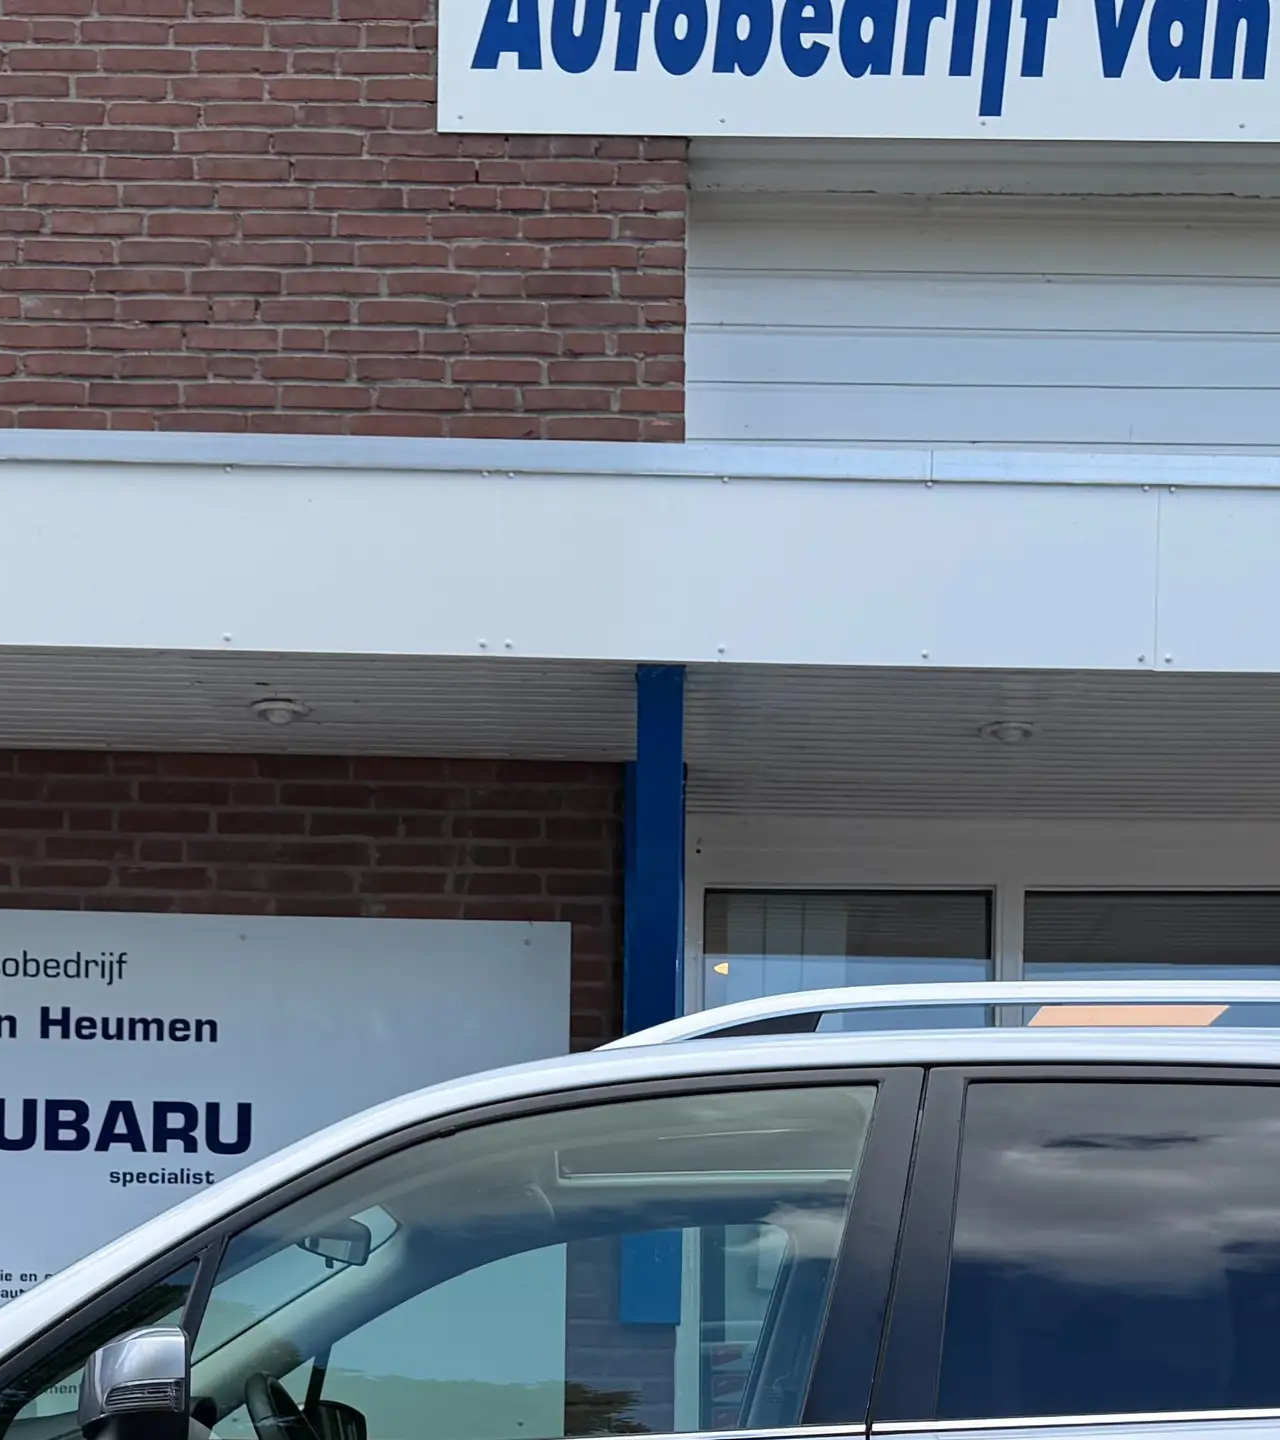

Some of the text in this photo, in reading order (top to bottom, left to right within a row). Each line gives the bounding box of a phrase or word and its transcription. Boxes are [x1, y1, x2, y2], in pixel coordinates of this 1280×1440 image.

[1095, 0, 1270, 81] van
[40, 1006, 218, 1043] Heumen
[109, 1167, 215, 1187] specialist
[19, 1273, 38, 1282] en
